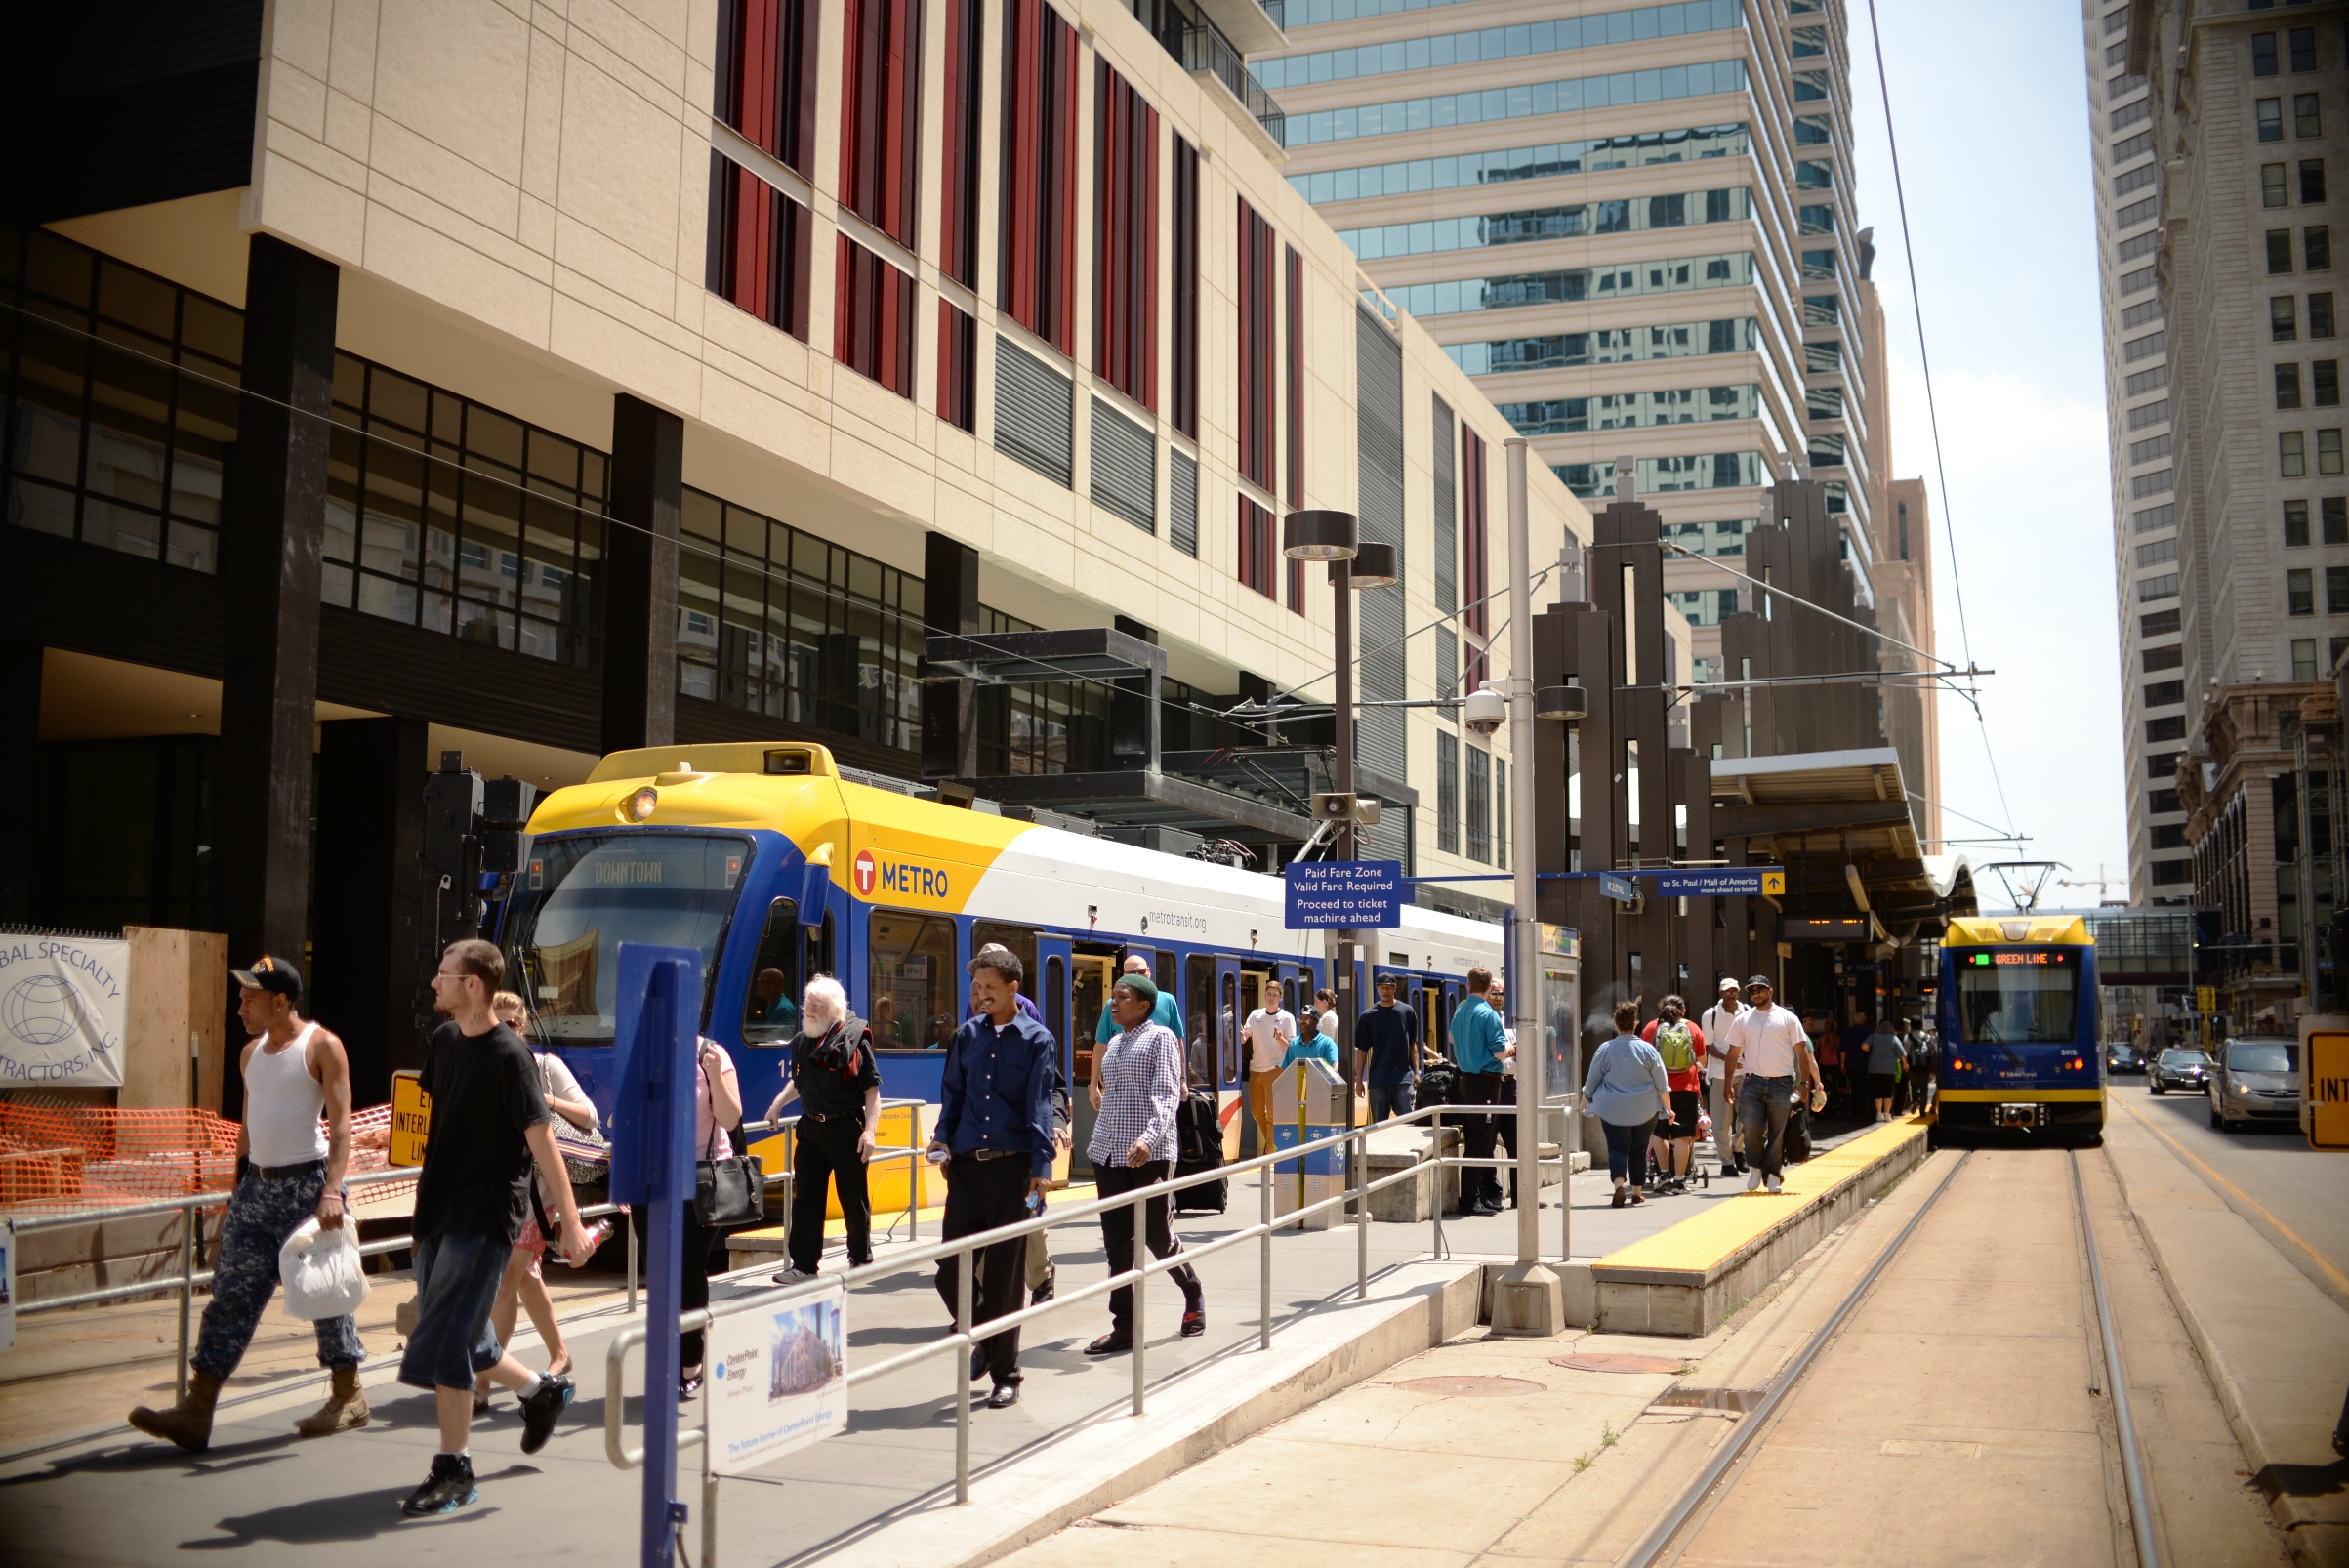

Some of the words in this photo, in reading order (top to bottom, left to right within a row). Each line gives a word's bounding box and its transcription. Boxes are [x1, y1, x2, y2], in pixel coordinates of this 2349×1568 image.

[595, 861, 662, 883] DOWNTOWN
[882, 861, 948, 897] METRO
[1305, 868, 1327, 878] Paid
[1330, 867, 1351, 877] Fare
[1355, 867, 1382, 877] Zone
[1294, 882, 1318, 891] Valid
[1322, 881, 1343, 891] Fare
[1347, 881, 1393, 893] Required
[1297, 899, 1339, 909] Proceed
[1343, 900, 1355, 909] to
[1358, 899, 1388, 909] ticket
[1149, 910, 1207, 933] metrotransit.org
[1304, 913, 1347, 923] machine
[1350, 912, 1381, 923] ahead
[1996, 954, 2024, 965] GREEN
[2026, 953, 2048, 964] LINE
[38, 942, 121, 999] SPECIALTY
[88, 1031, 118, 1063] INC.
[726, 1348, 760, 1367] CenterPoint
[726, 1368, 747, 1381] Energy
[728, 1443, 740, 1454] The
[741, 1436, 759, 1450] future
[760, 1431, 775, 1443] home
[777, 1425, 783, 1436] of
[783, 1416, 814, 1434] CenterPoint
[815, 1410, 833, 1423] Energy
